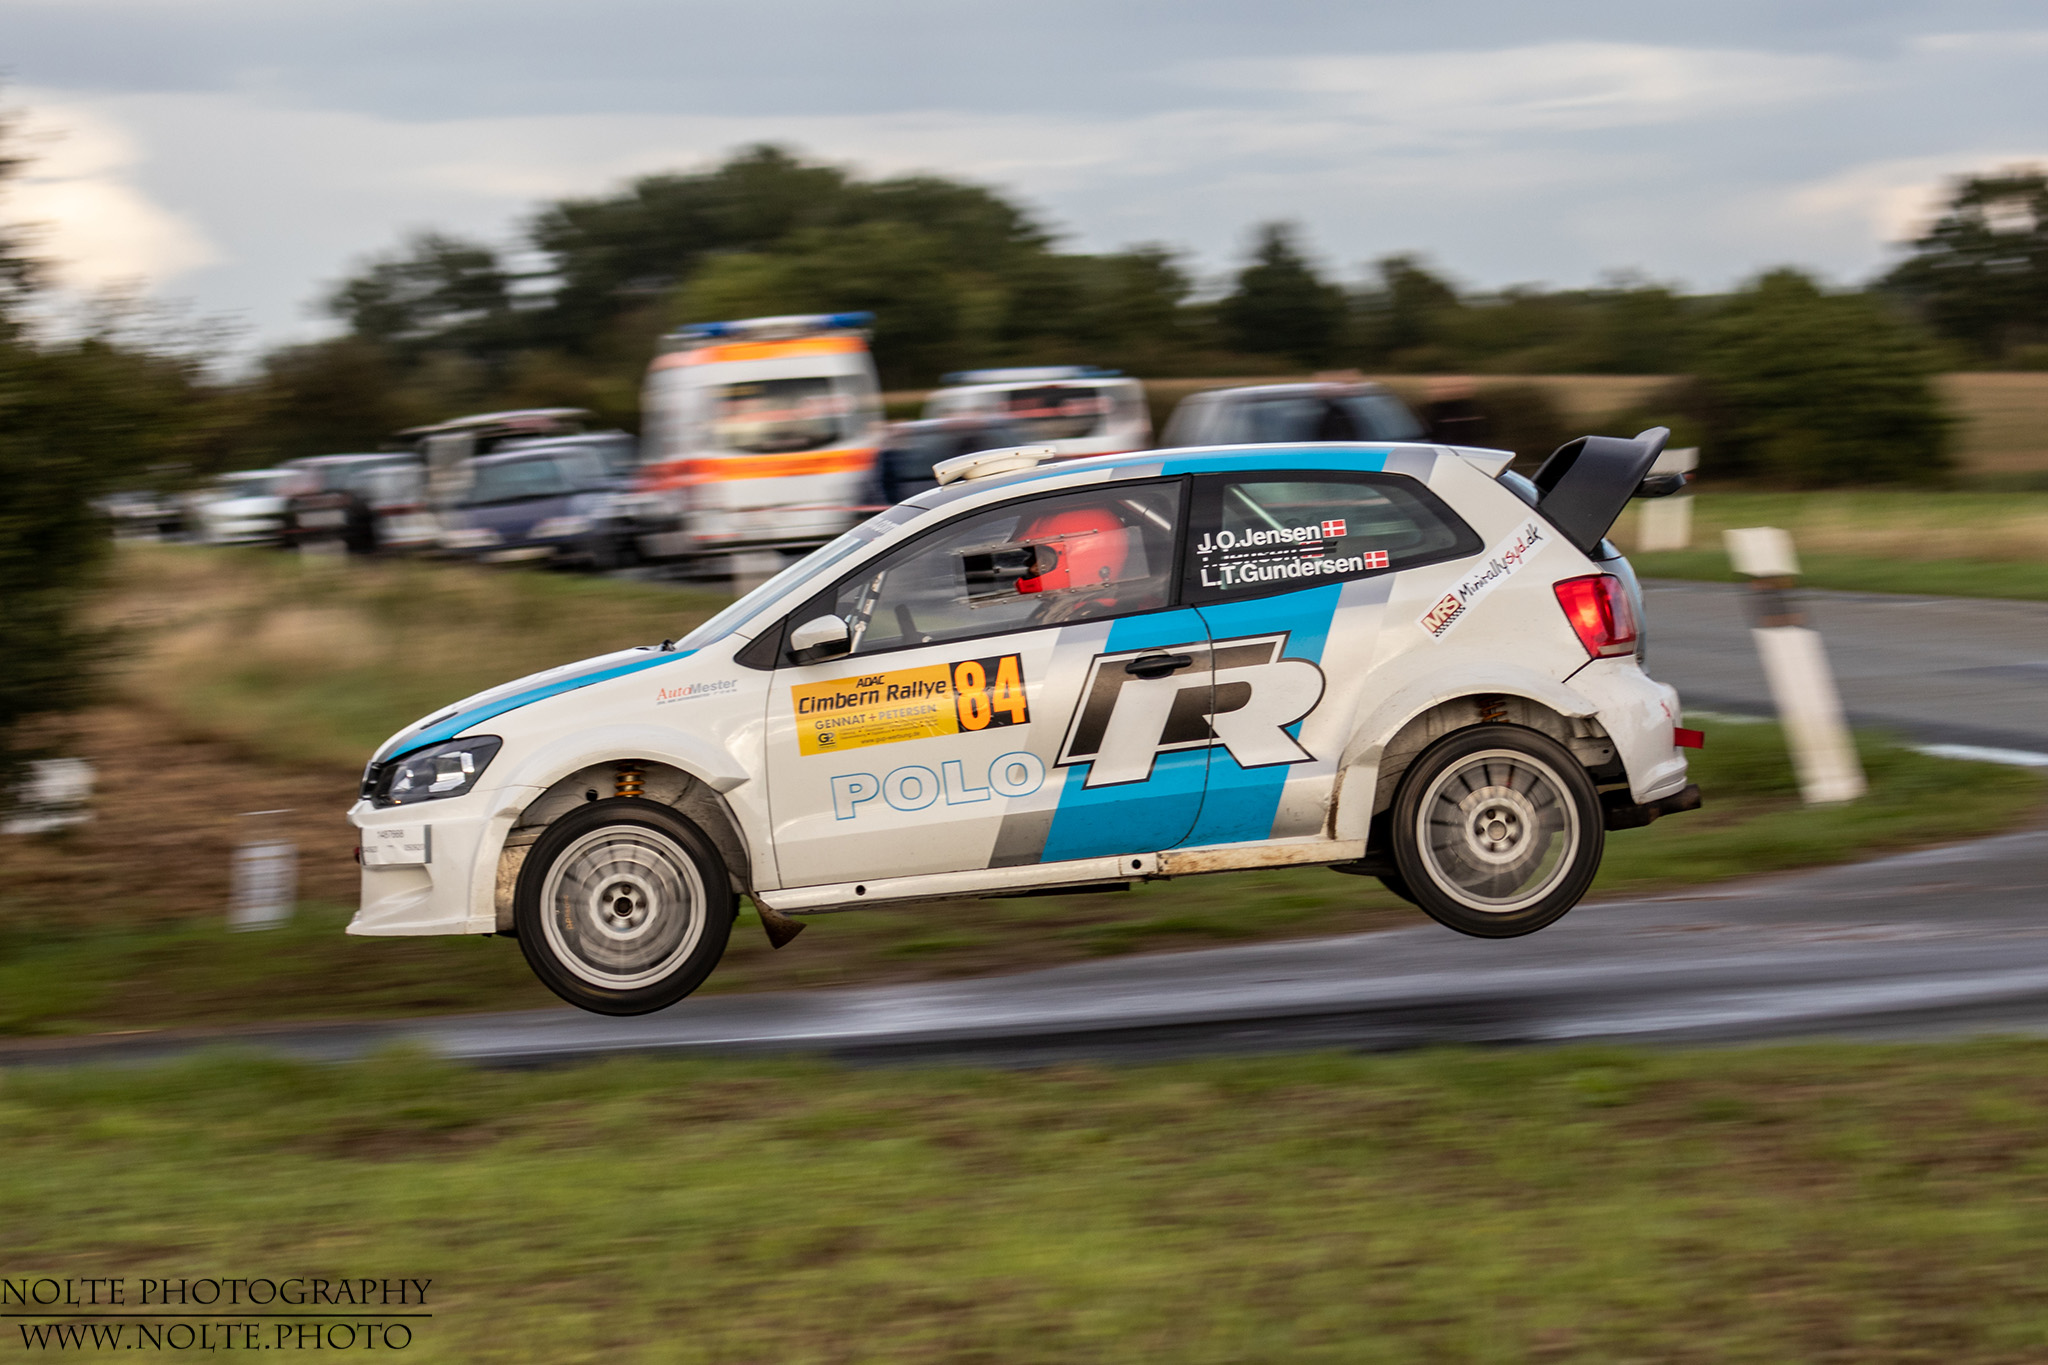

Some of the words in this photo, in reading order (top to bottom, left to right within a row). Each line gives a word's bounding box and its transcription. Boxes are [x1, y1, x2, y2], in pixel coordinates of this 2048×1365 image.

[1197, 525, 1321, 551] J.O.Jensen
[1200, 556, 1364, 587] L.T.Gundersen
[1421, 594, 1462, 632] MRS
[656, 679, 738, 701] AutoMester
[799, 688, 879, 715] Cimbern
[886, 680, 947, 702] Rallye
[856, 674, 885, 688] ADAC
[954, 655, 1027, 731] 84
[814, 713, 866, 730] GENNAT
[878, 704, 937, 721] PETERSEN
[1054, 630, 1326, 790] R
[830, 750, 1046, 821] POLO
